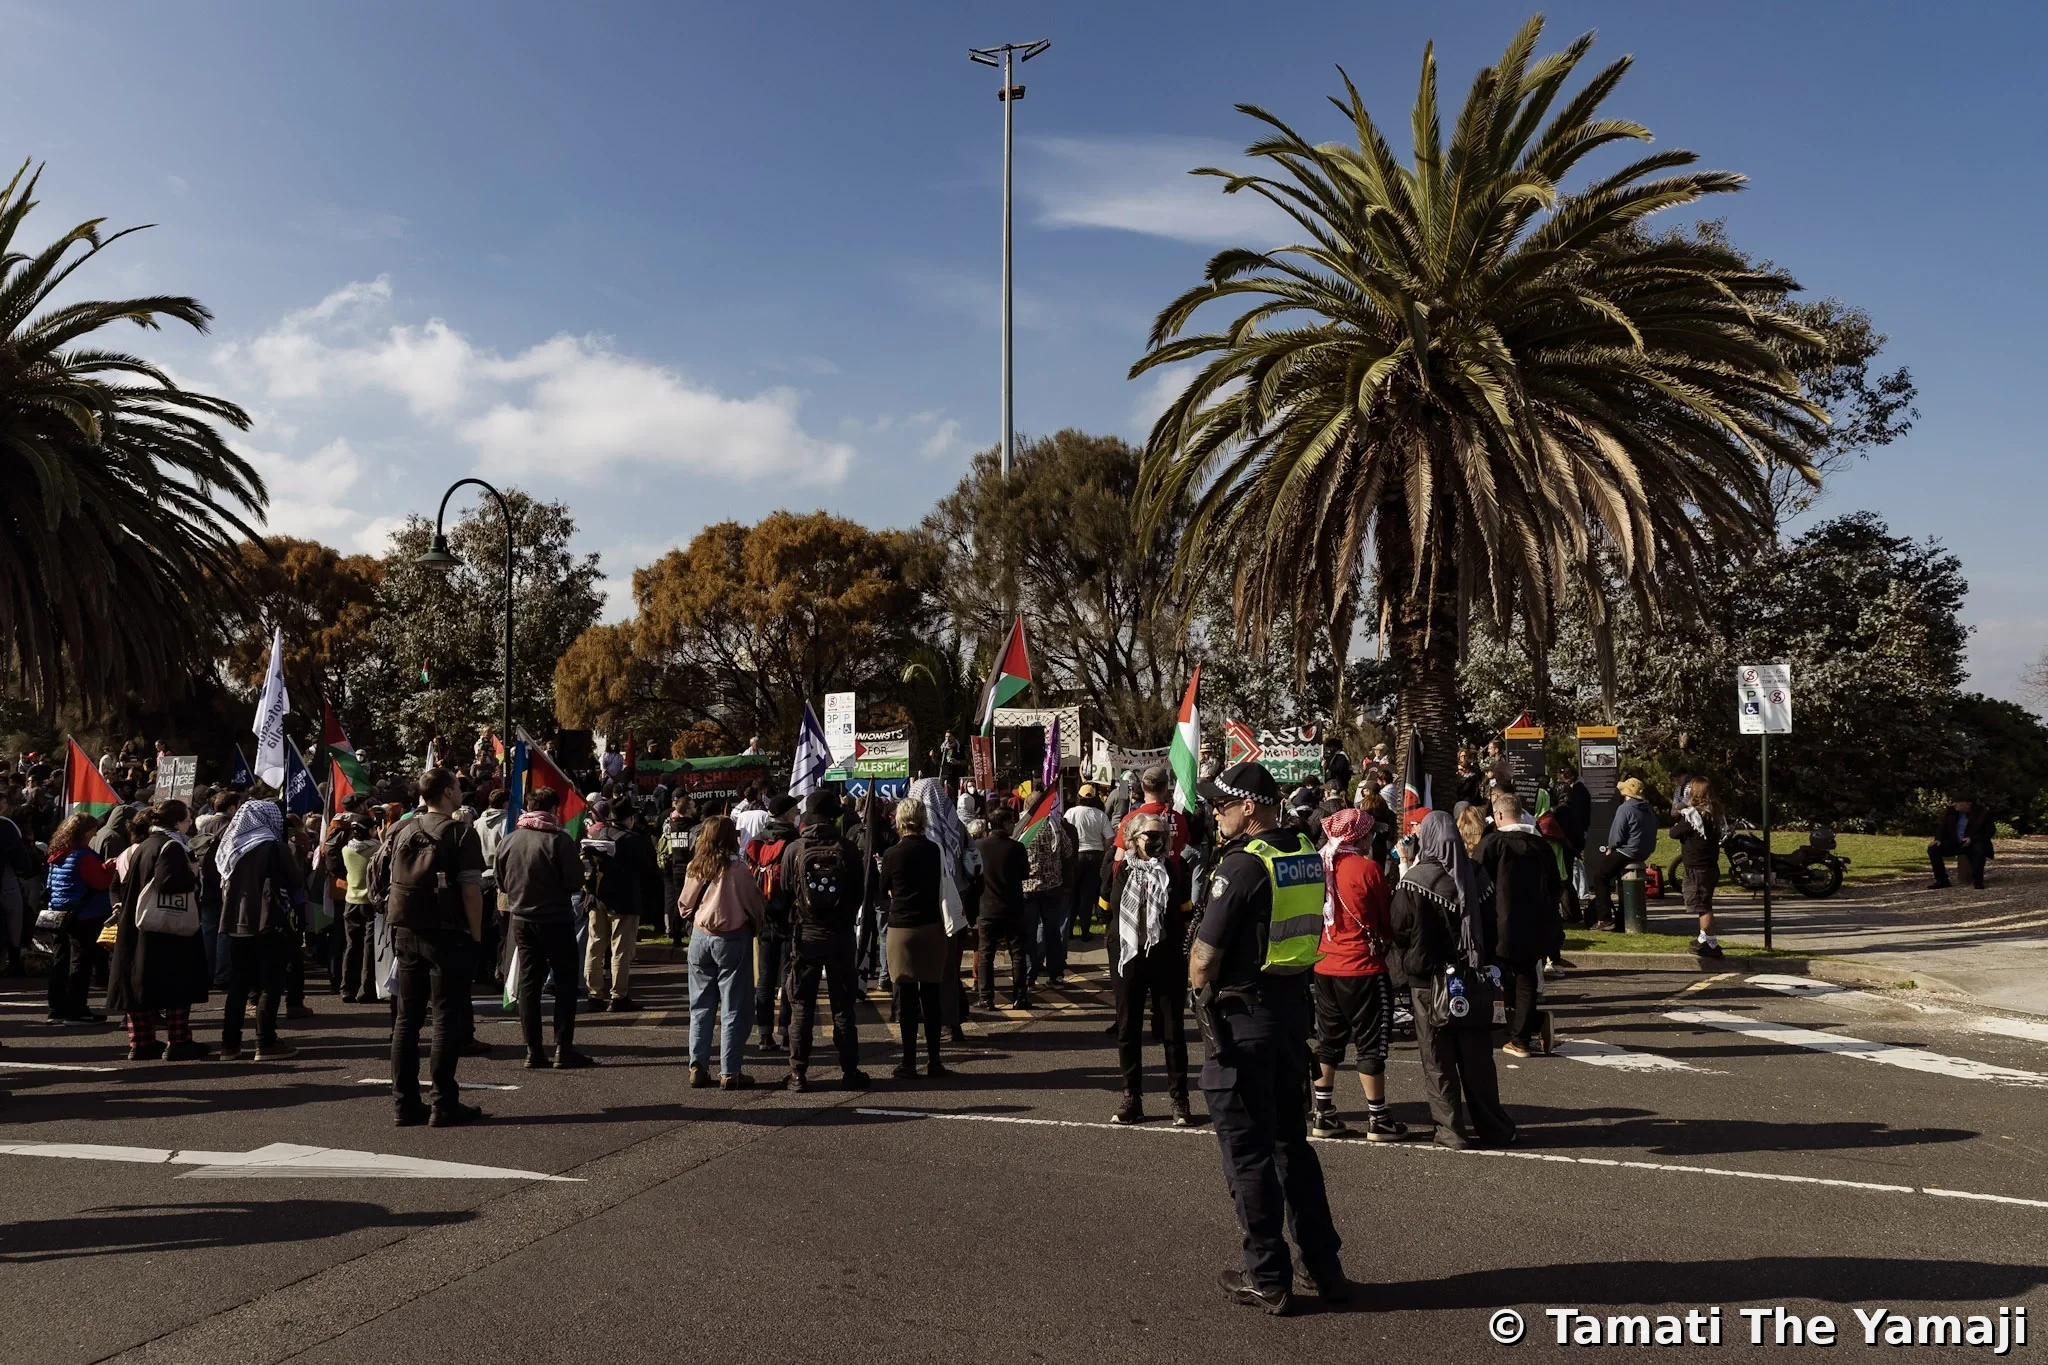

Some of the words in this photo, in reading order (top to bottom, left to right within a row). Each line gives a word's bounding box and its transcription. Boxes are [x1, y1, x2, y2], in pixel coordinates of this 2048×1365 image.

[1747, 691, 1756, 701] P
[826, 714, 838, 724] 3P
[1258, 726, 1317, 744] ASU
[868, 746, 888, 755] FOR
[1264, 748, 1319, 758] Members
[159, 759, 174, 774] YOUR
[178, 760, 196, 774] MOVE
[854, 762, 906, 773] PALESTINE
[703, 769, 763, 783] CHARGES
[715, 790, 726, 798] TO
[1276, 860, 1322, 882] Police
